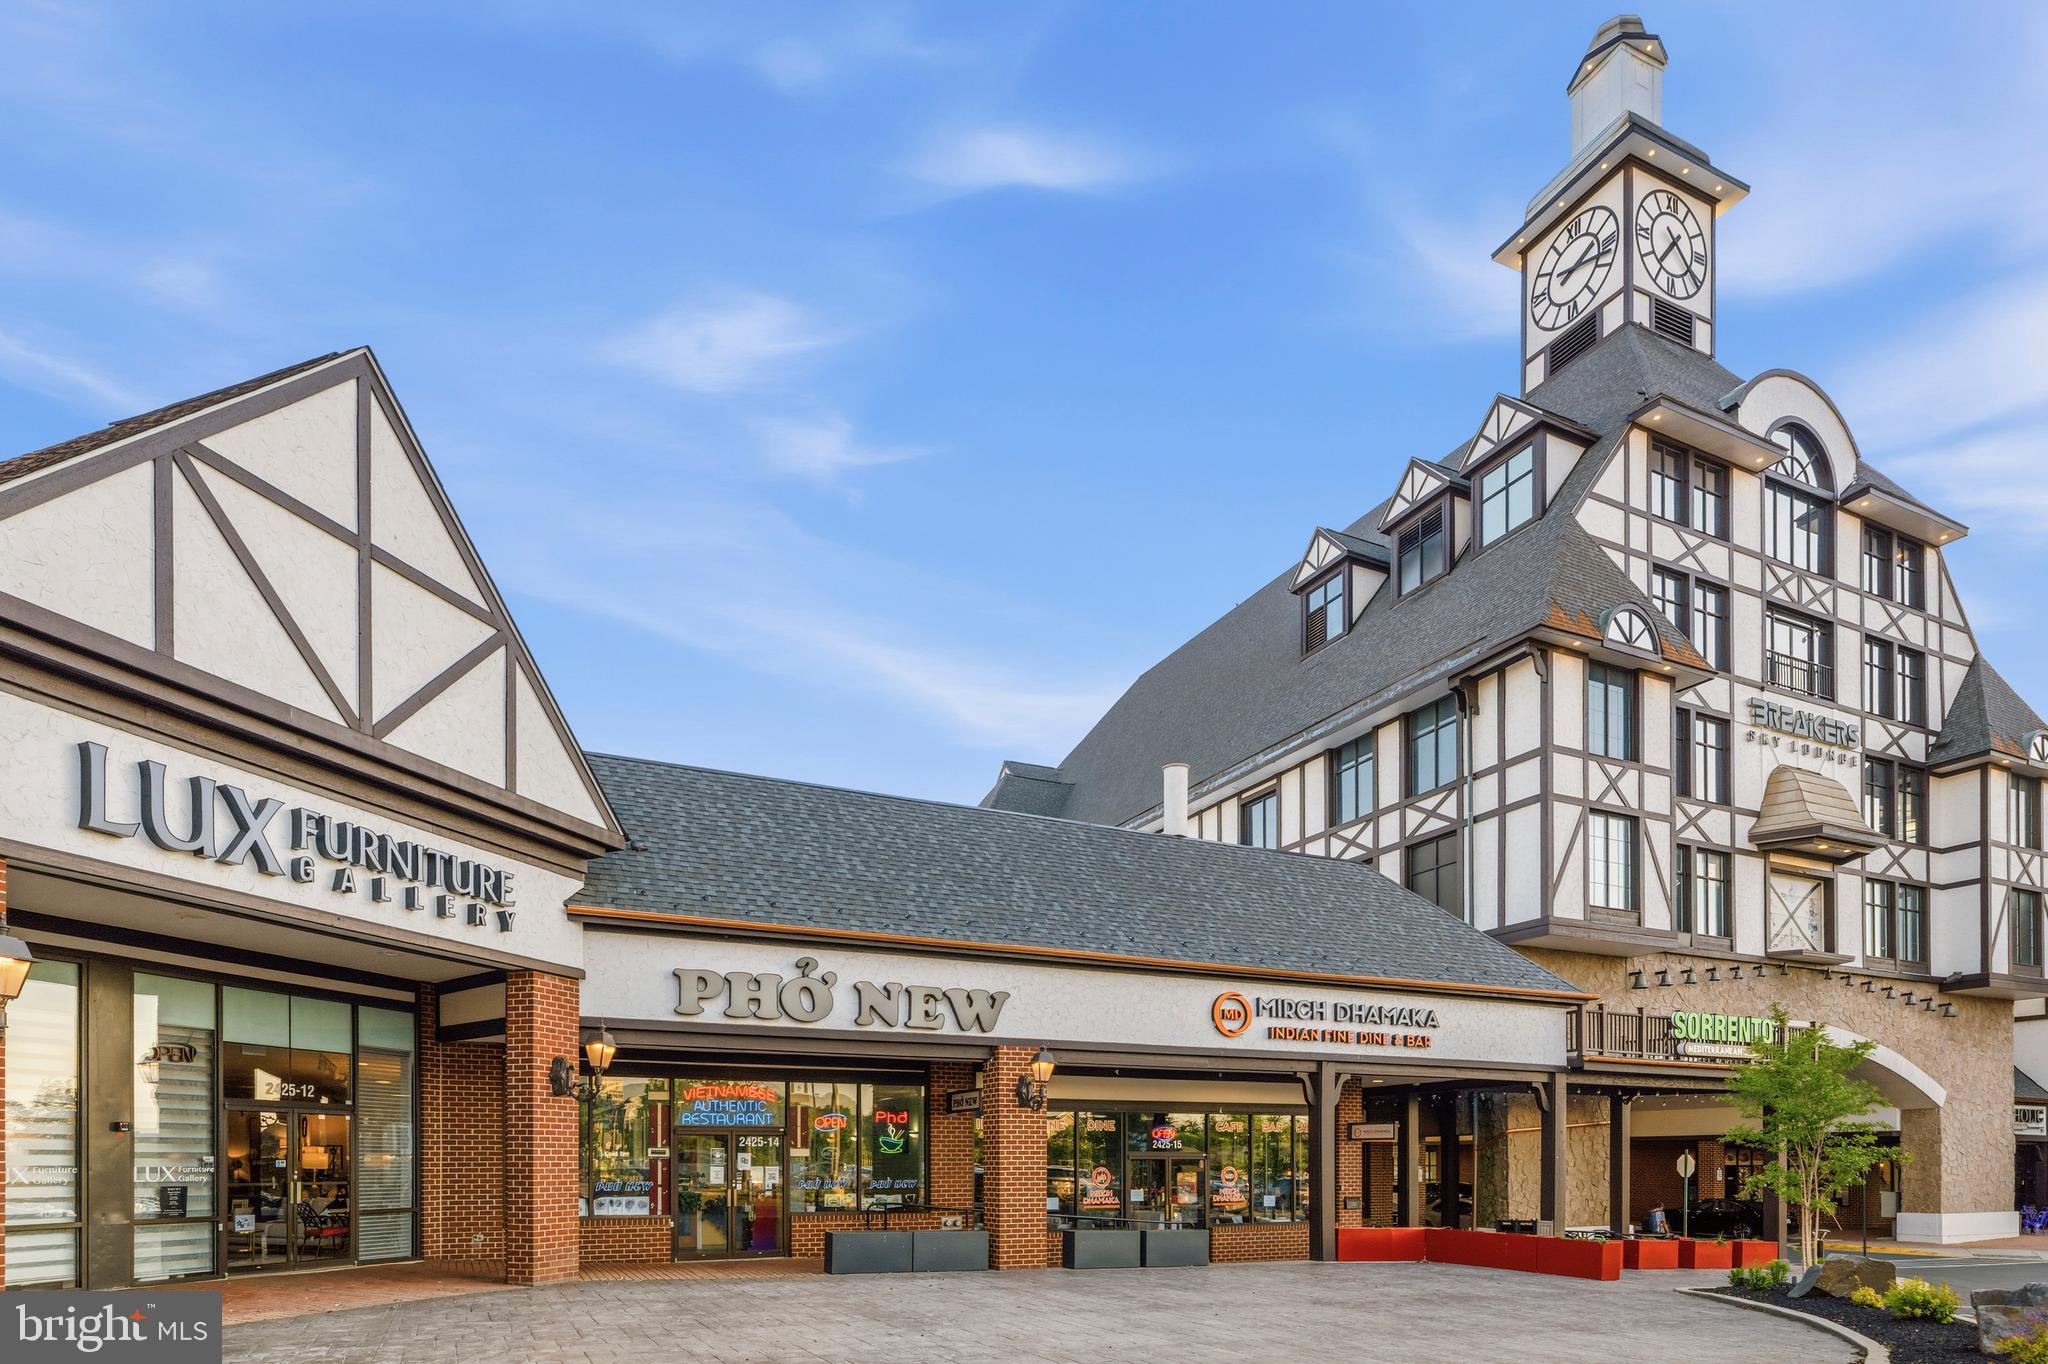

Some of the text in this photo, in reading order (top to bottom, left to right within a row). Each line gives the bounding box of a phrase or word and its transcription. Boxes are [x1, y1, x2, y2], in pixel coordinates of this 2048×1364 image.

[1666, 193, 1679, 215] XII
[1567, 218, 1581, 244] XII
[1747, 696, 1860, 749] BREAKERS
[1747, 730, 1780, 748] SKY
[77, 741, 286, 876] LUX
[290, 808, 516, 907] FURNITURE
[290, 855, 516, 932] GALLERY
[853, 981, 1011, 1033] NEW
[1221, 1008, 1243, 1020] MD
[1256, 996, 1440, 1029] MIRCH DHAMAKA
[1671, 1010, 1774, 1044] SORRENTO
[1267, 1026, 1432, 1048] INDIAN FINE DINE & BAR
[265, 1082, 315, 1098] 2425-12
[683, 1085, 776, 1102] VIETNAMESE
[694, 1099, 767, 1112] AUTHENTIC
[682, 1112, 772, 1125] RESTAURANT
[815, 1116, 847, 1129] OPEN
[1087, 1119, 1116, 1131] DINE
[1215, 1121, 1244, 1132] CAFE
[1262, 1122, 1284, 1133] BAR
[739, 1136, 780, 1147] 2425-14
[1152, 1140, 1182, 1149] 2425-15
[32, 1166, 78, 1174] Furniture
[133, 1166, 176, 1183] LUX
[178, 1165, 215, 1173] Furniture
[178, 1174, 208, 1183] Gallery
